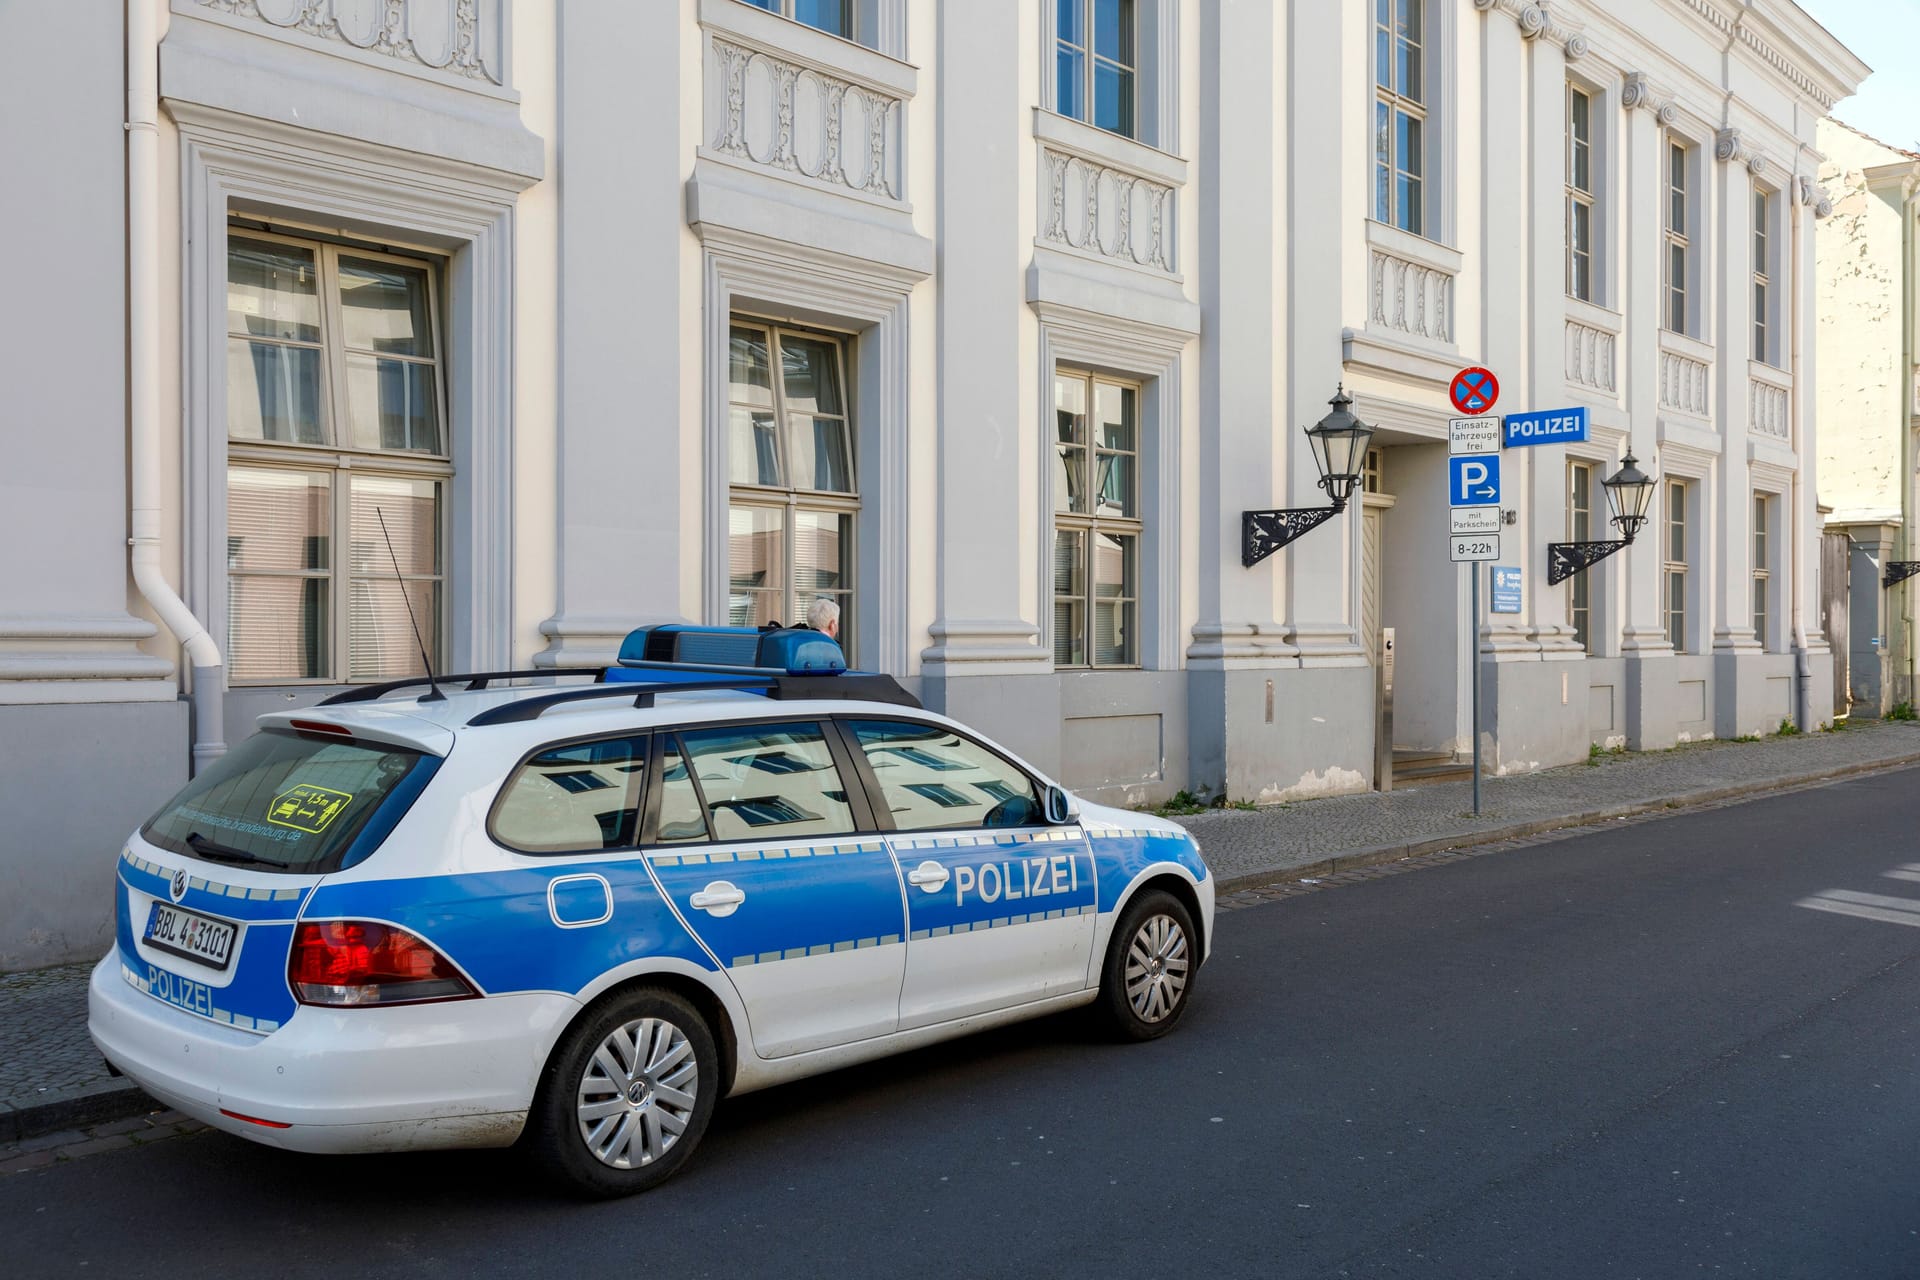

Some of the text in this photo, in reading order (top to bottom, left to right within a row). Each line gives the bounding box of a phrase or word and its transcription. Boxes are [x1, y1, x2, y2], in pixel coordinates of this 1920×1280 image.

[1455, 421, 1494, 430] Einsatz-
[1510, 416, 1580, 438] POLIZEI
[1452, 432, 1498, 442] fahrzeuge
[1467, 442, 1483, 451] frei
[1461, 462, 1488, 500] P
[1468, 511, 1482, 520] mit
[1453, 521, 1497, 529] Parkschein
[1457, 542, 1492, 555] 8-22h
[954, 854, 1078, 907] POLIZEI
[154, 908, 229, 959] BBL 4 3101
[148, 966, 212, 1016] POLIZEI
